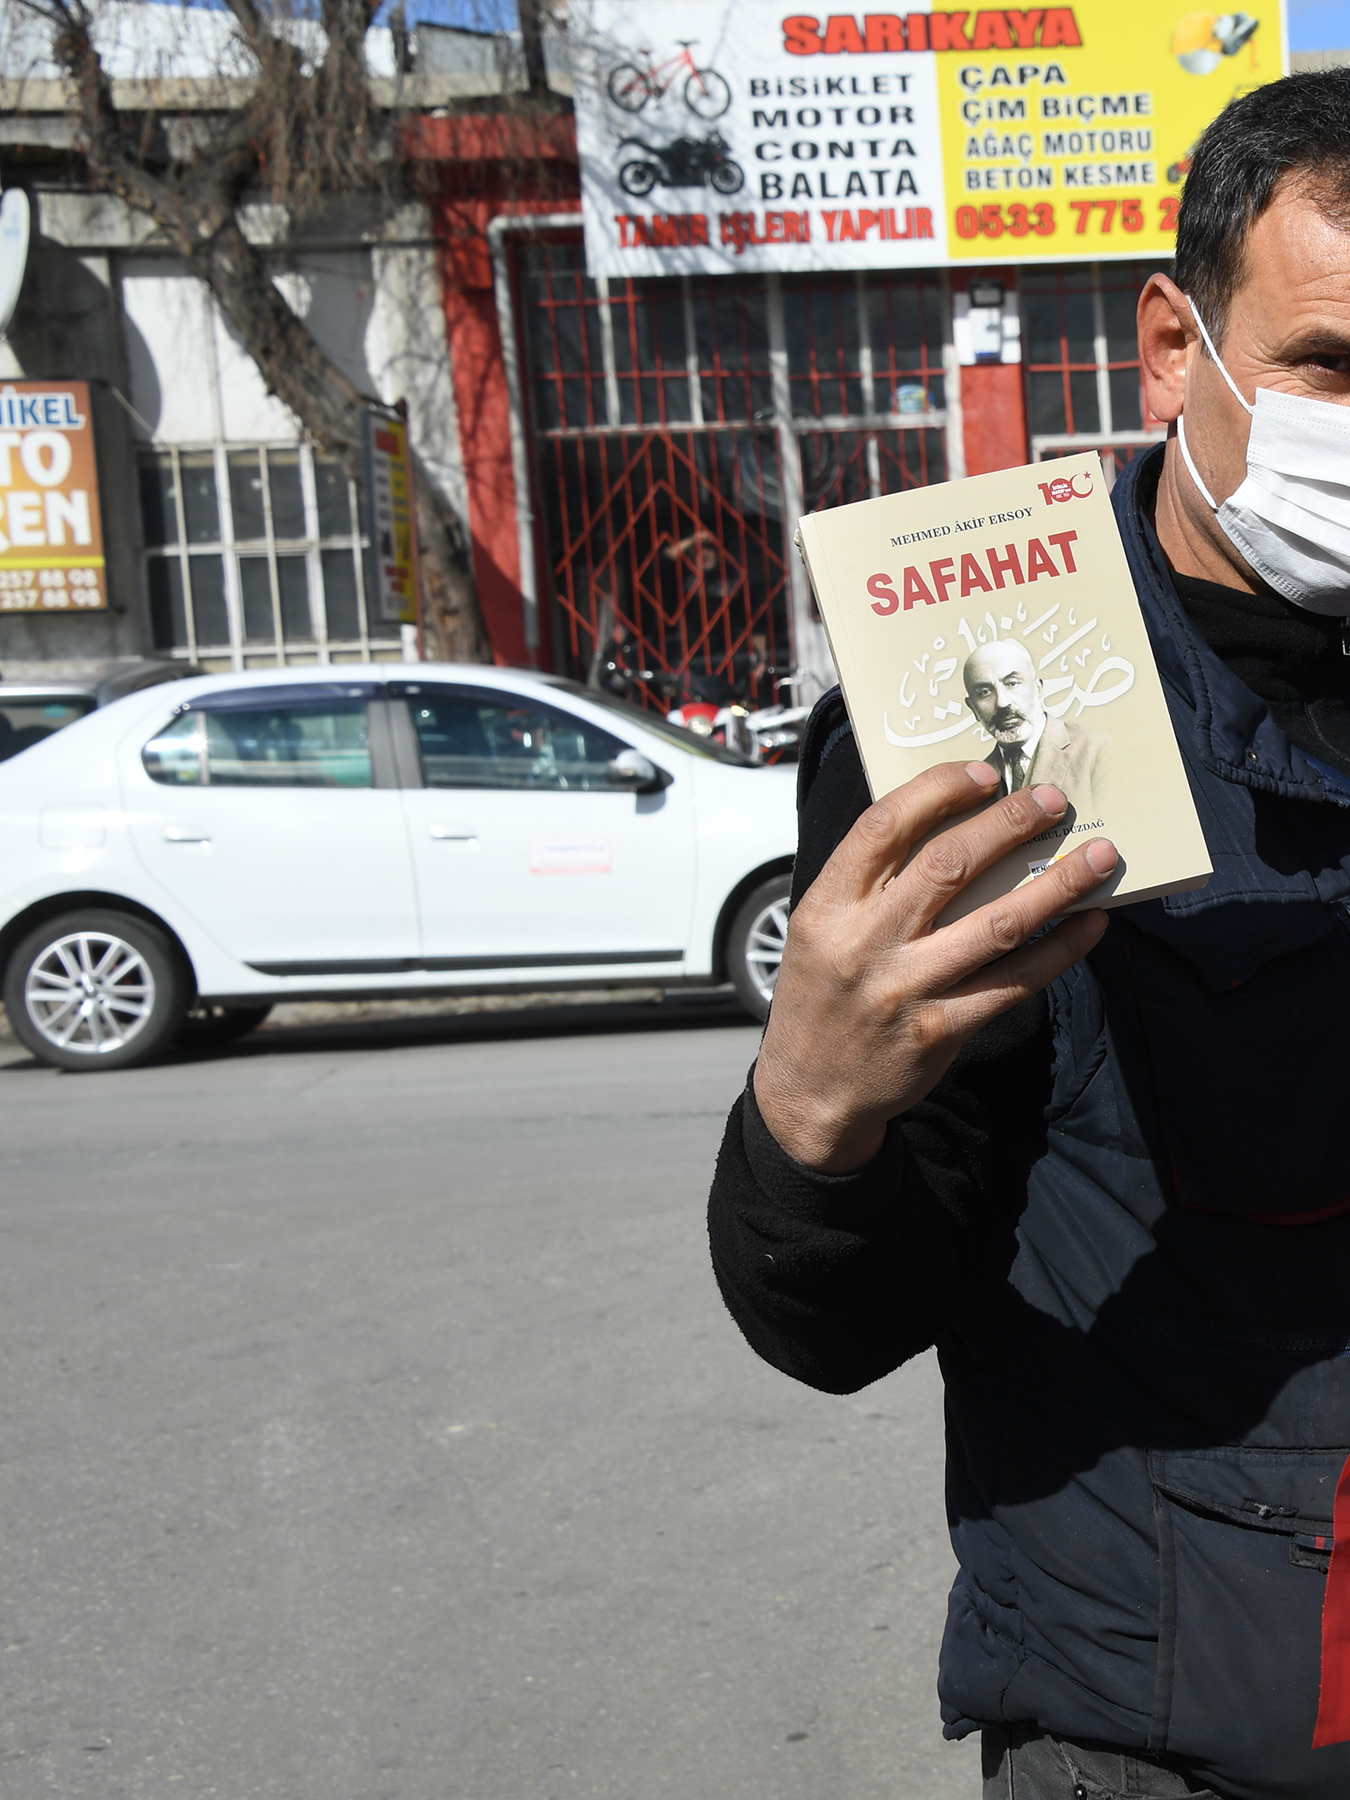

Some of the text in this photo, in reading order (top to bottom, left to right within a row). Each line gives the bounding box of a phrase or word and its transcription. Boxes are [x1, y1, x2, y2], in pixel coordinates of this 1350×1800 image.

[782, 7, 1083, 56] SARIKAYA
[960, 64, 1066, 94] ÇAPA
[752, 106, 915, 128] MOTOR
[755, 139, 917, 163] CONTA
[966, 129, 1153, 163] AĞAÇ MOTORU
[760, 169, 919, 200] BALATA
[966, 161, 1155, 191] BETON KESME
[820, 207, 934, 242] YAPILIR
[955, 202, 1056, 239] 0533
[1069, 198, 1144, 234] 775
[890, 507, 1034, 547] MEHMED ÂKİF ERSOY
[866, 530, 1079, 616] SAFAHAT
